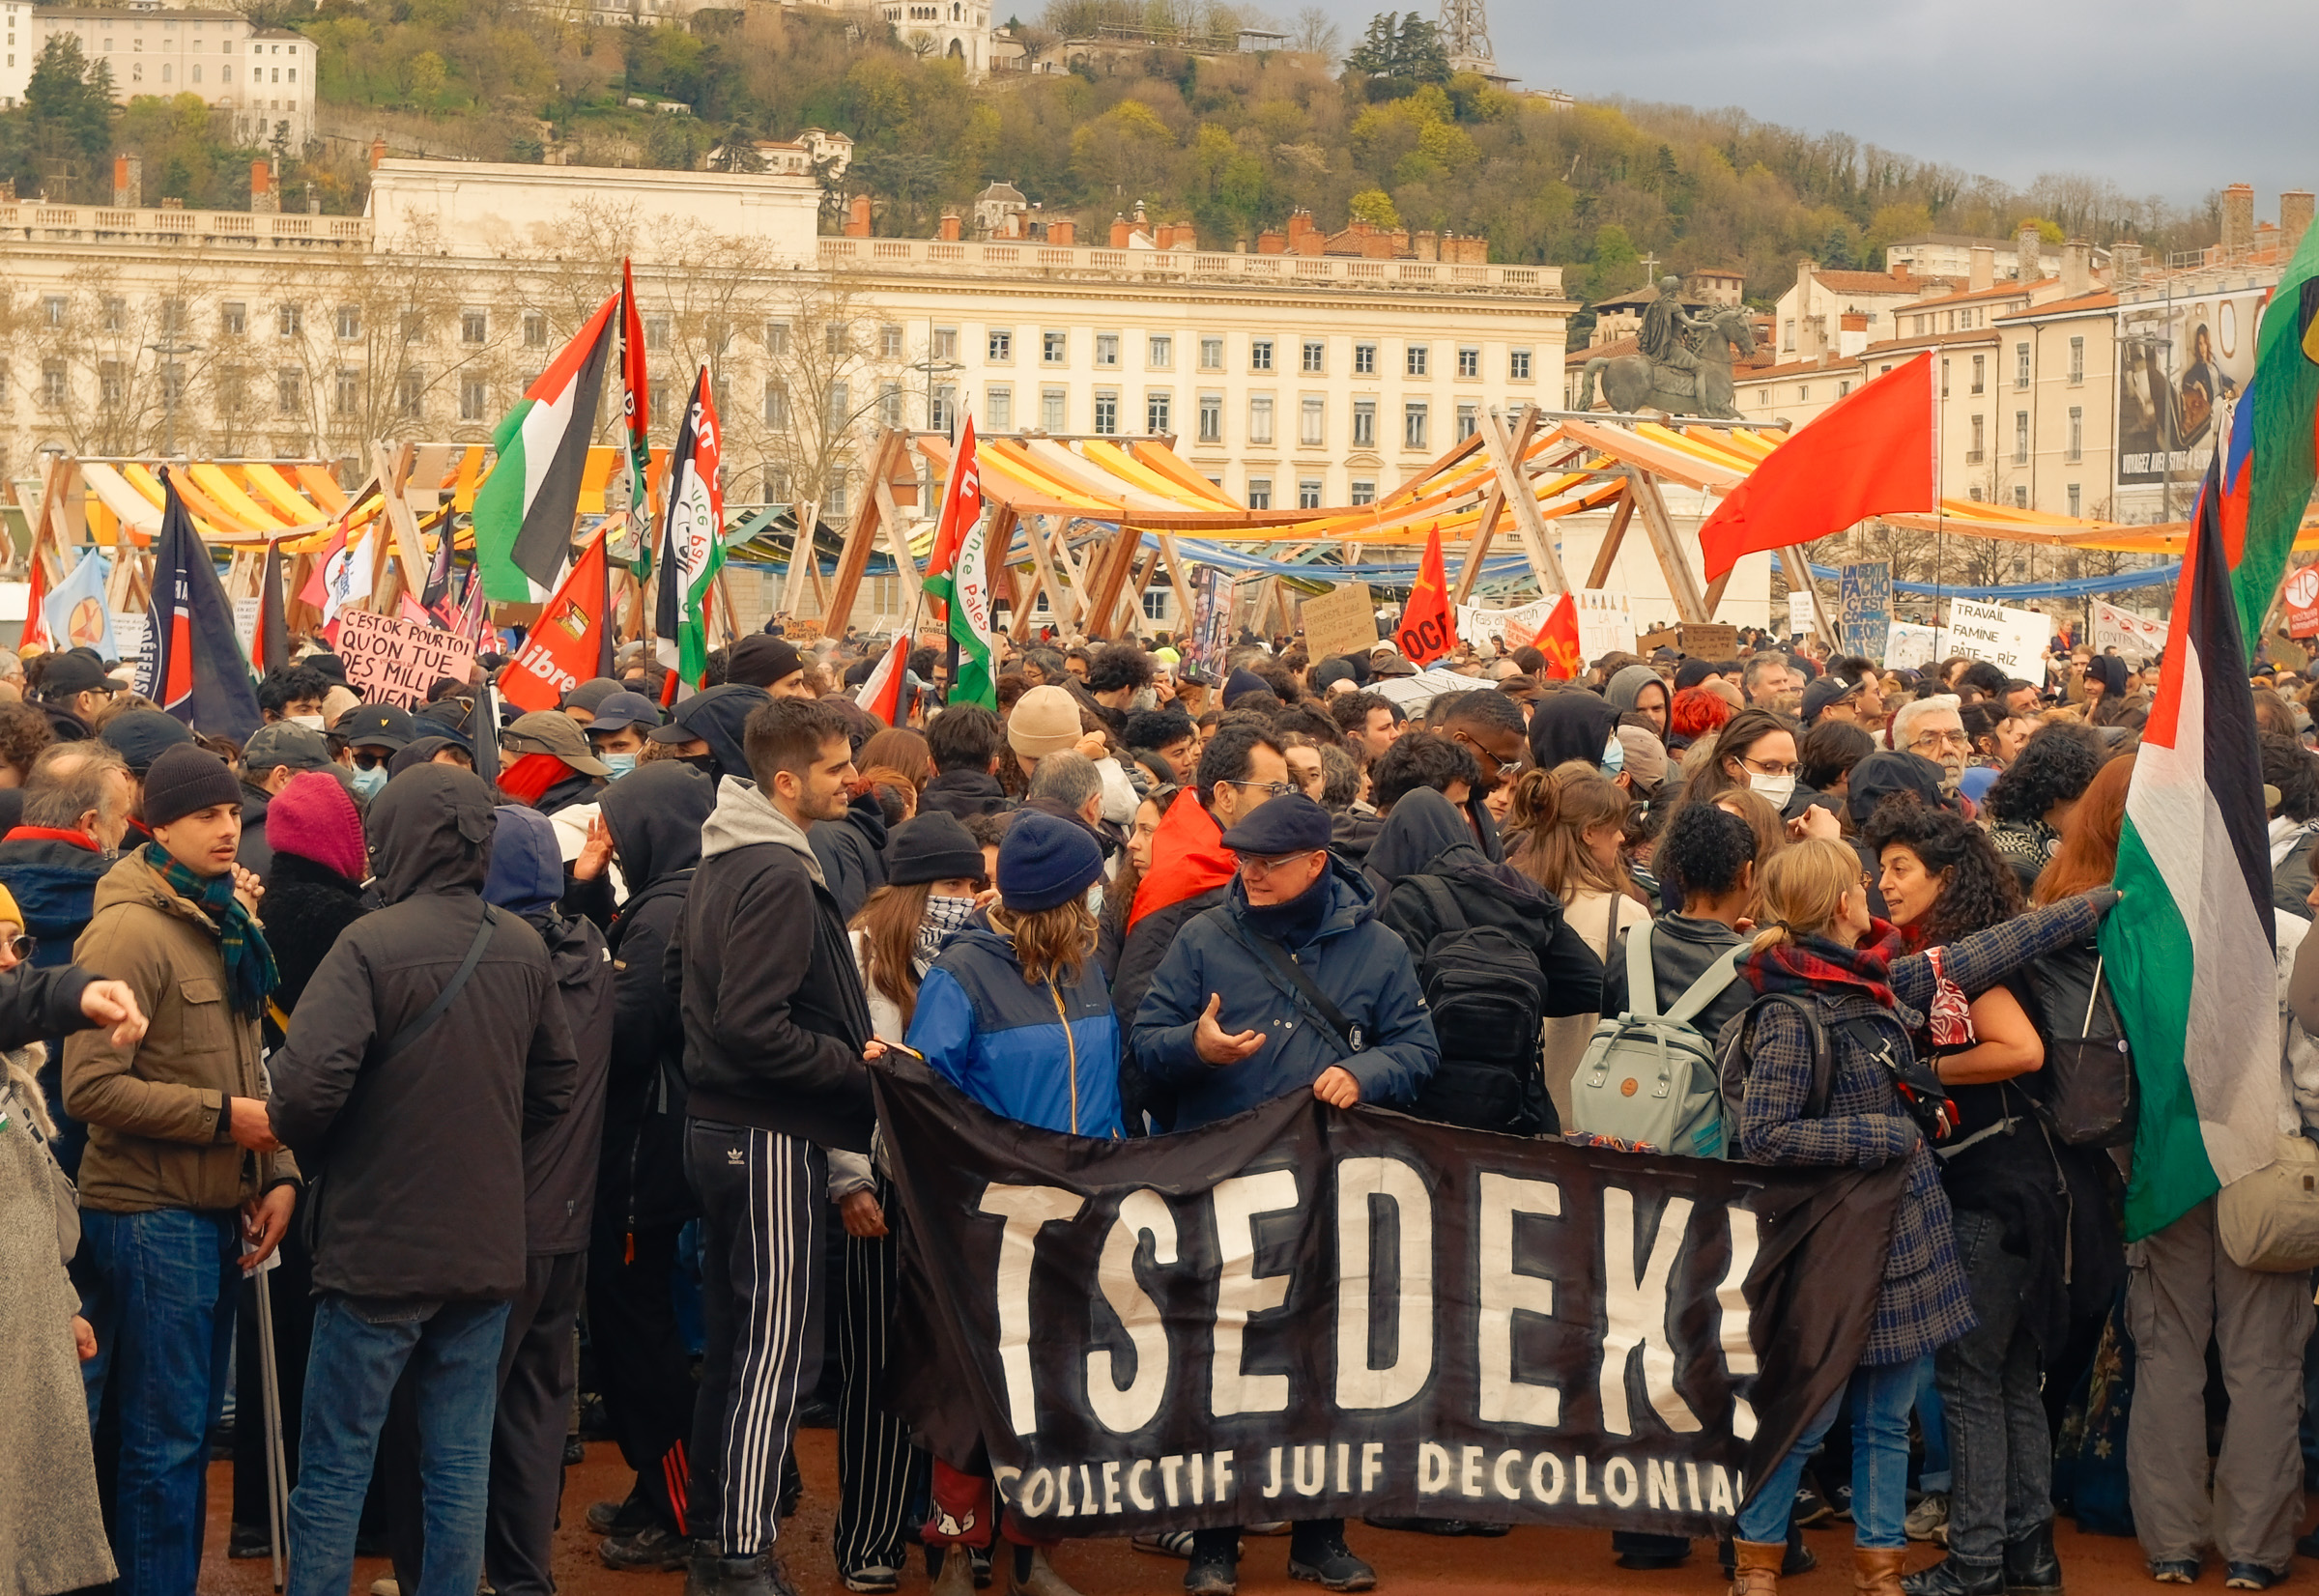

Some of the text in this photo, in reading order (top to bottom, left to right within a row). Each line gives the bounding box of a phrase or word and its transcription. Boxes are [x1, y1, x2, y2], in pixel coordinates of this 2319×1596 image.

[1841, 578, 1891, 604] FACHO
[1847, 596, 1886, 612] C'EST
[346, 612, 383, 632] C'EST
[382, 619, 403, 637] OK
[408, 626, 444, 649] POUR
[446, 636, 471, 656] TOI
[1599, 613, 1611, 624] LA
[341, 650, 376, 678] DES
[342, 630, 453, 675] QU'ON TUE
[978, 1156, 1760, 1441] TSEDEK!
[993, 1449, 1235, 1519] COLLECTIF
[1262, 1442, 1385, 1499] JUIF
